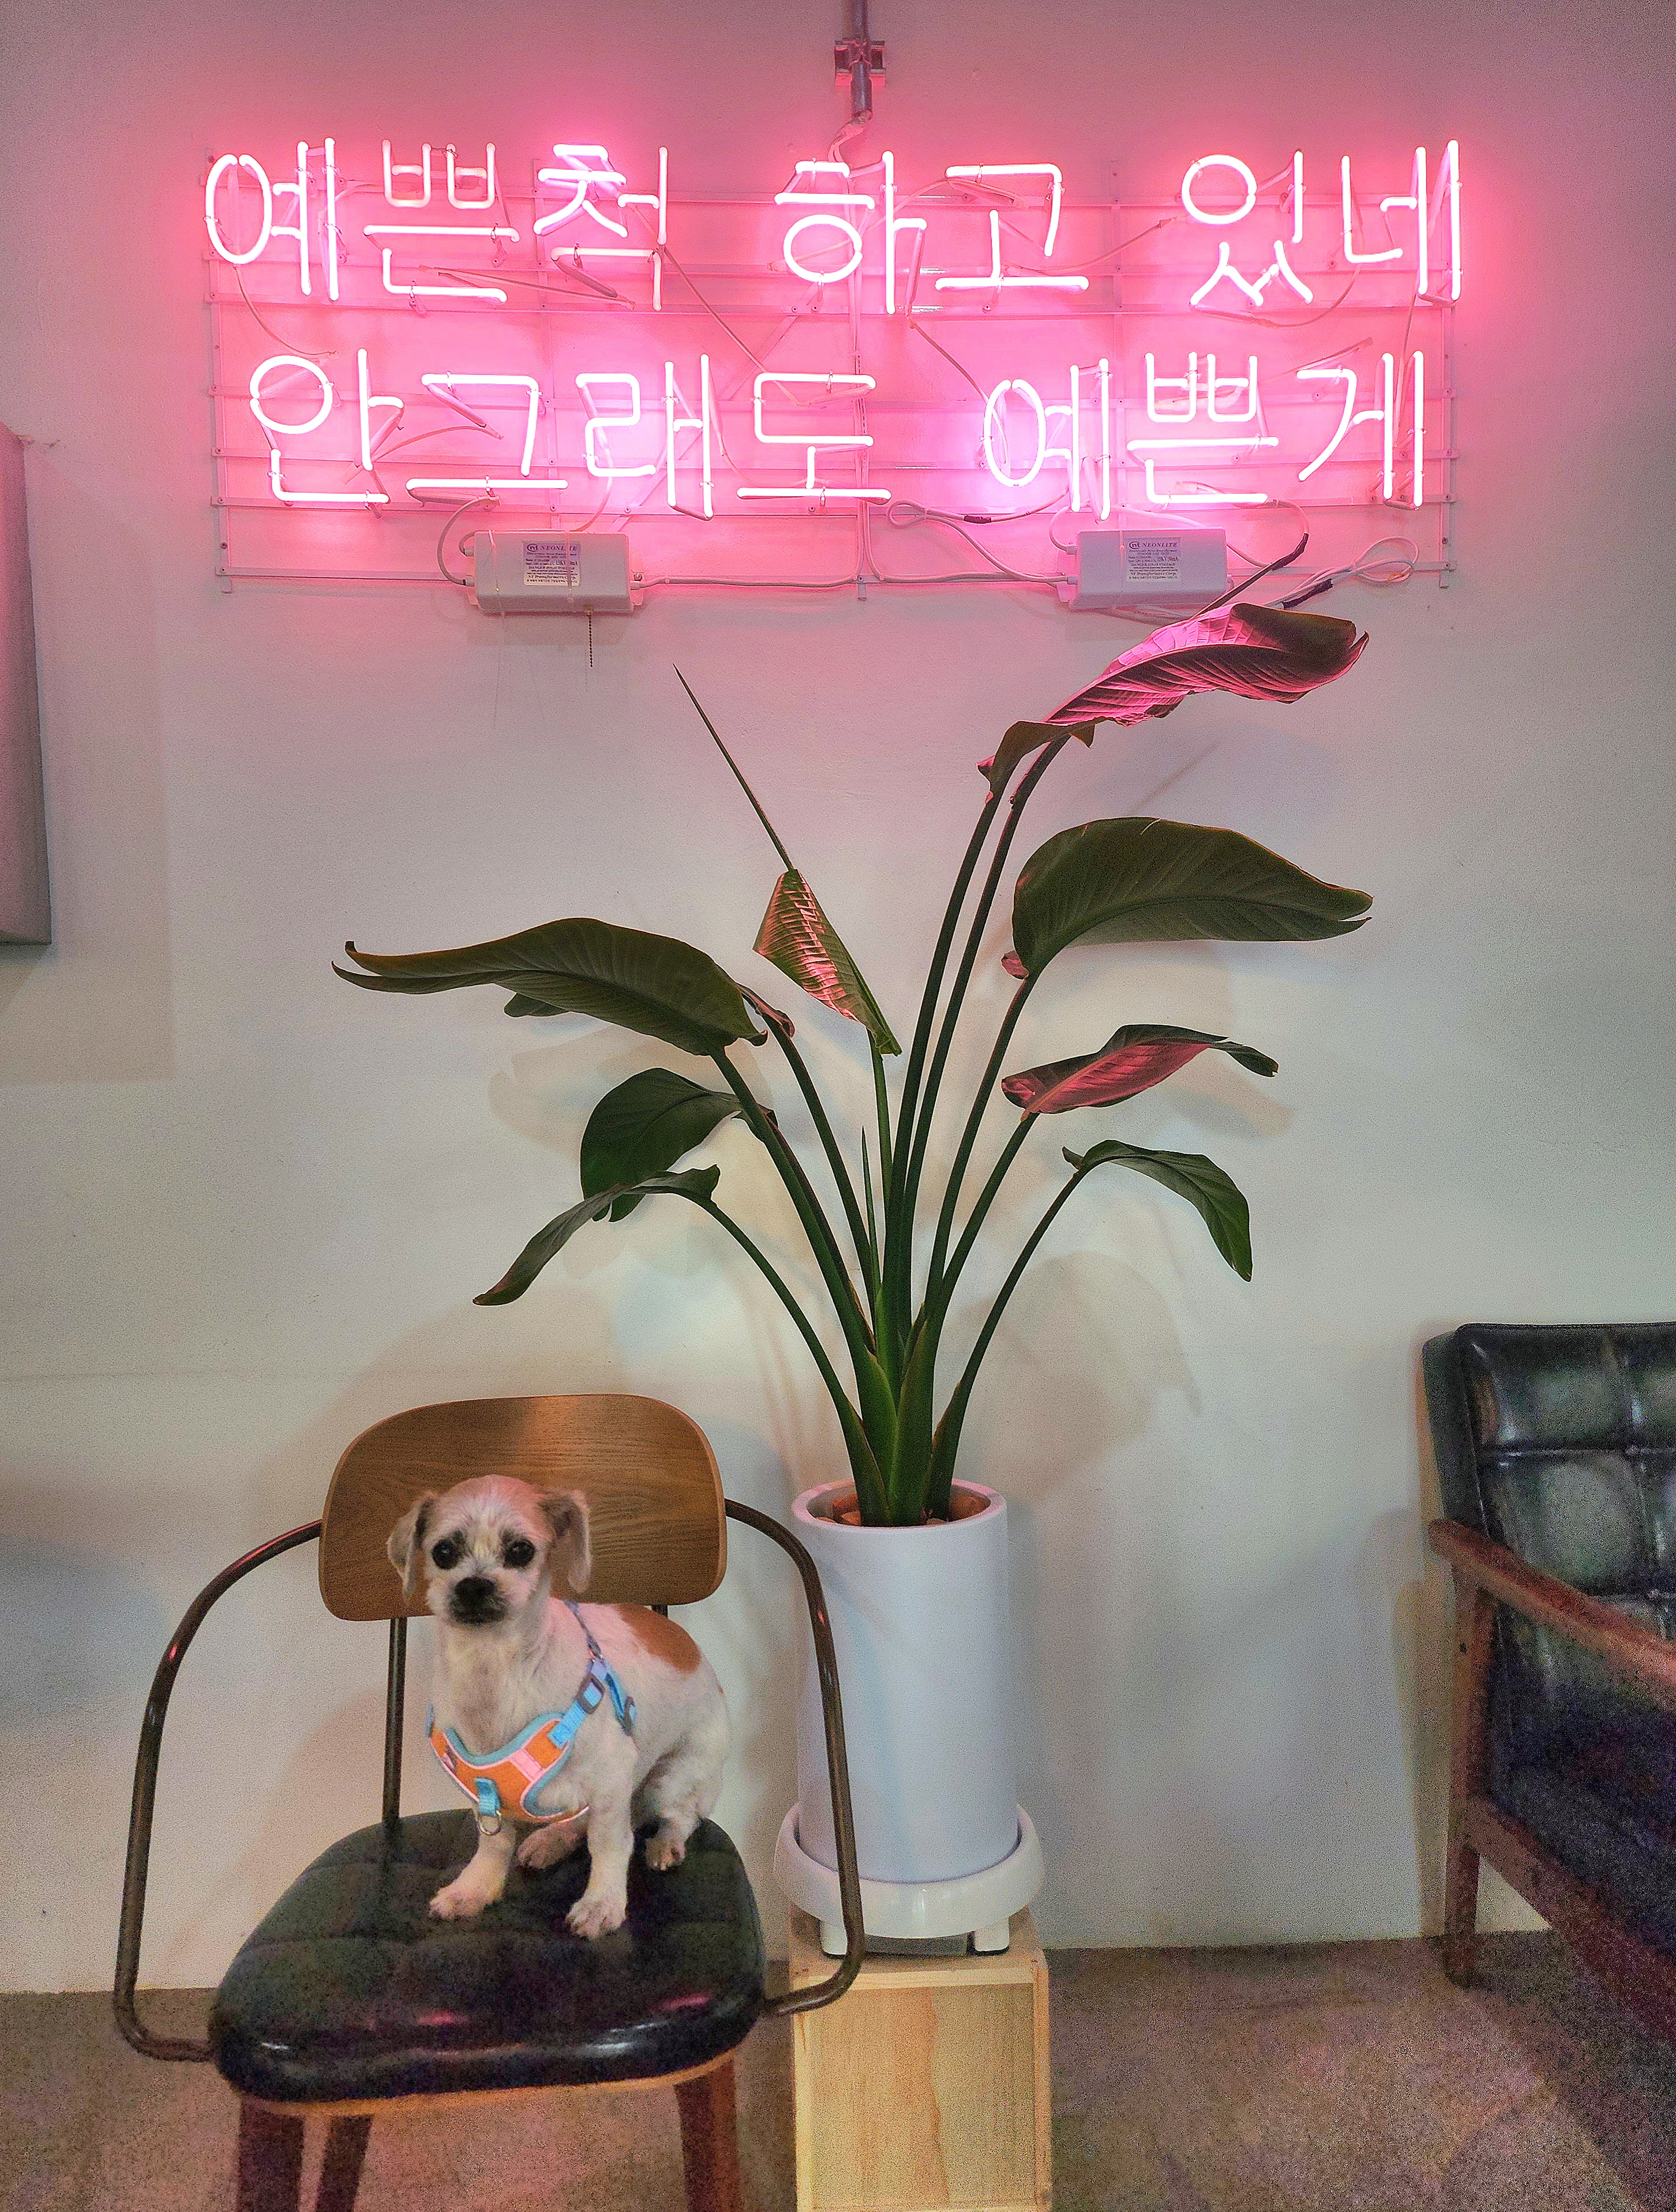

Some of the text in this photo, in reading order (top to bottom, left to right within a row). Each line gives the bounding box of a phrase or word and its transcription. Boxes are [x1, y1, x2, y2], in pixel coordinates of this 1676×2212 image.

[205, 137, 1462, 315] 예쁜척 하고 있네
[249, 348, 892, 518] 안그래도
[982, 350, 1424, 521] 예쁜게
